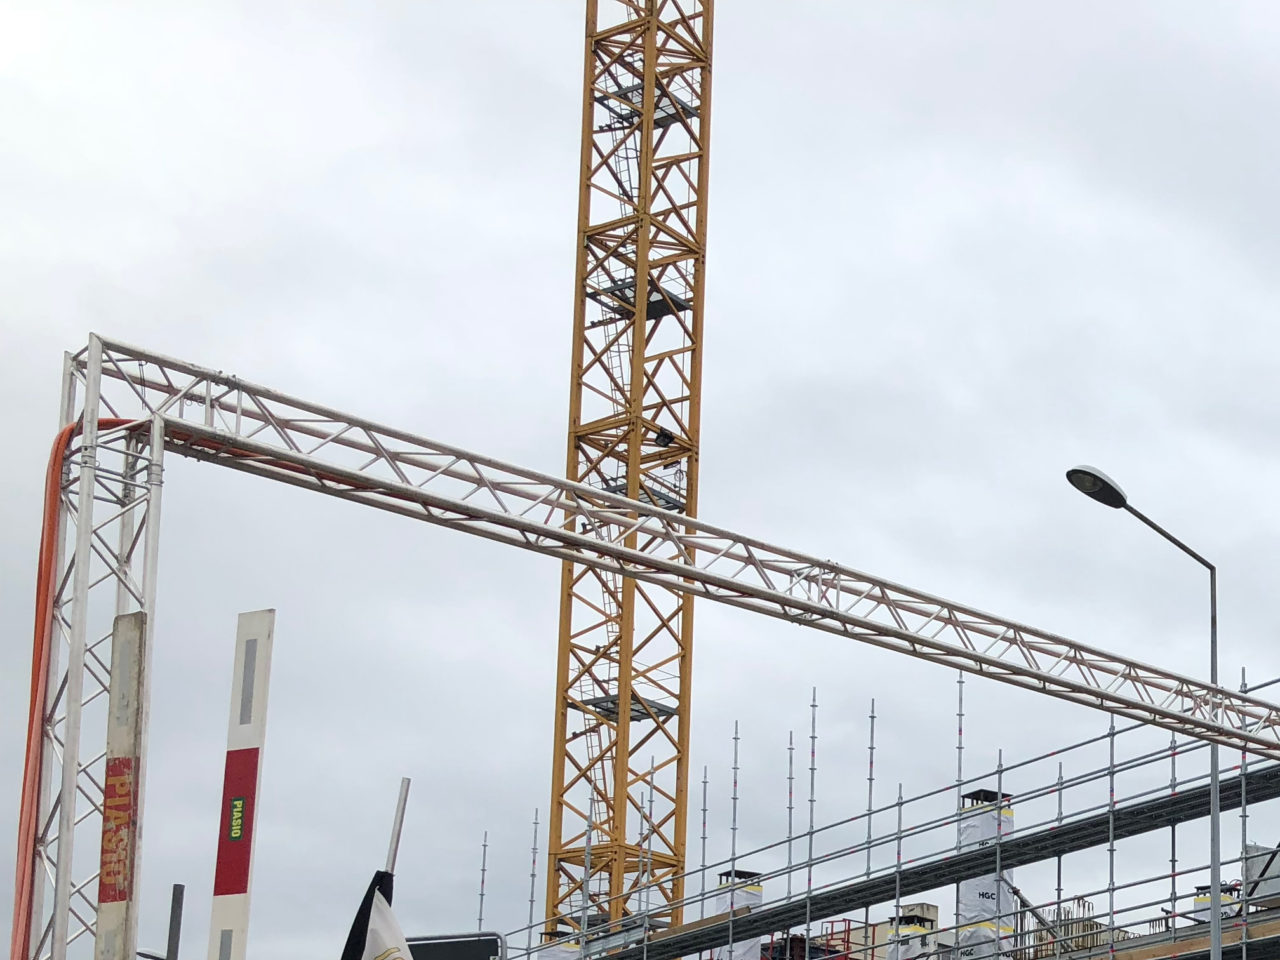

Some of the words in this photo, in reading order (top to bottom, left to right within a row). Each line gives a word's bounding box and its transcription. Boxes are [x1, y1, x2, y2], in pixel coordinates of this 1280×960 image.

[232, 800, 243, 837] PIASIO
[978, 892, 996, 900] HGC
[961, 949, 974, 957] HGC
